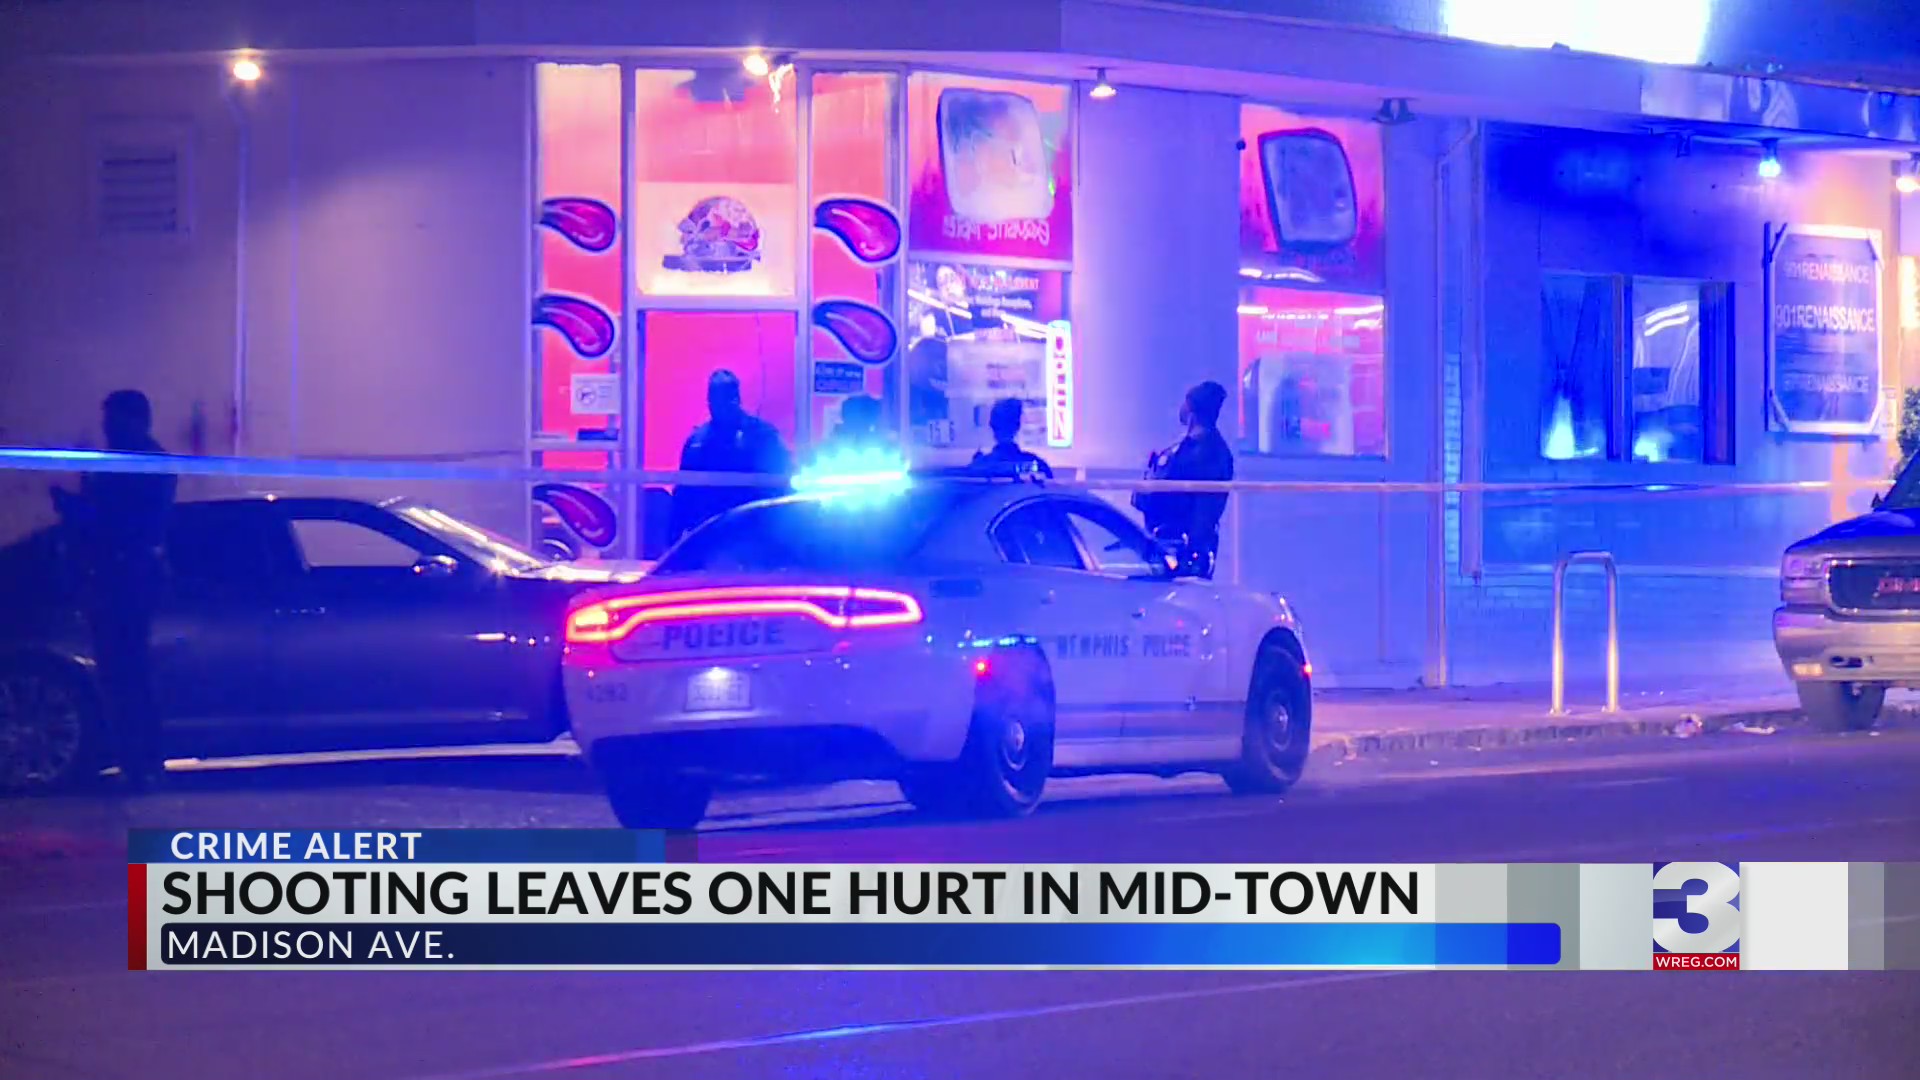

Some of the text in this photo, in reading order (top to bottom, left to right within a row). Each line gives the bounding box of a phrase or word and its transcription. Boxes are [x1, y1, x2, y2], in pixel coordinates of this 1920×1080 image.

[1775, 303, 1875, 332] 901RENAISSANCE
[1051, 329, 1067, 441] OPEN
[661, 619, 785, 651] POLICE
[1056, 634, 1191, 658] MEMPHIS POLICE
